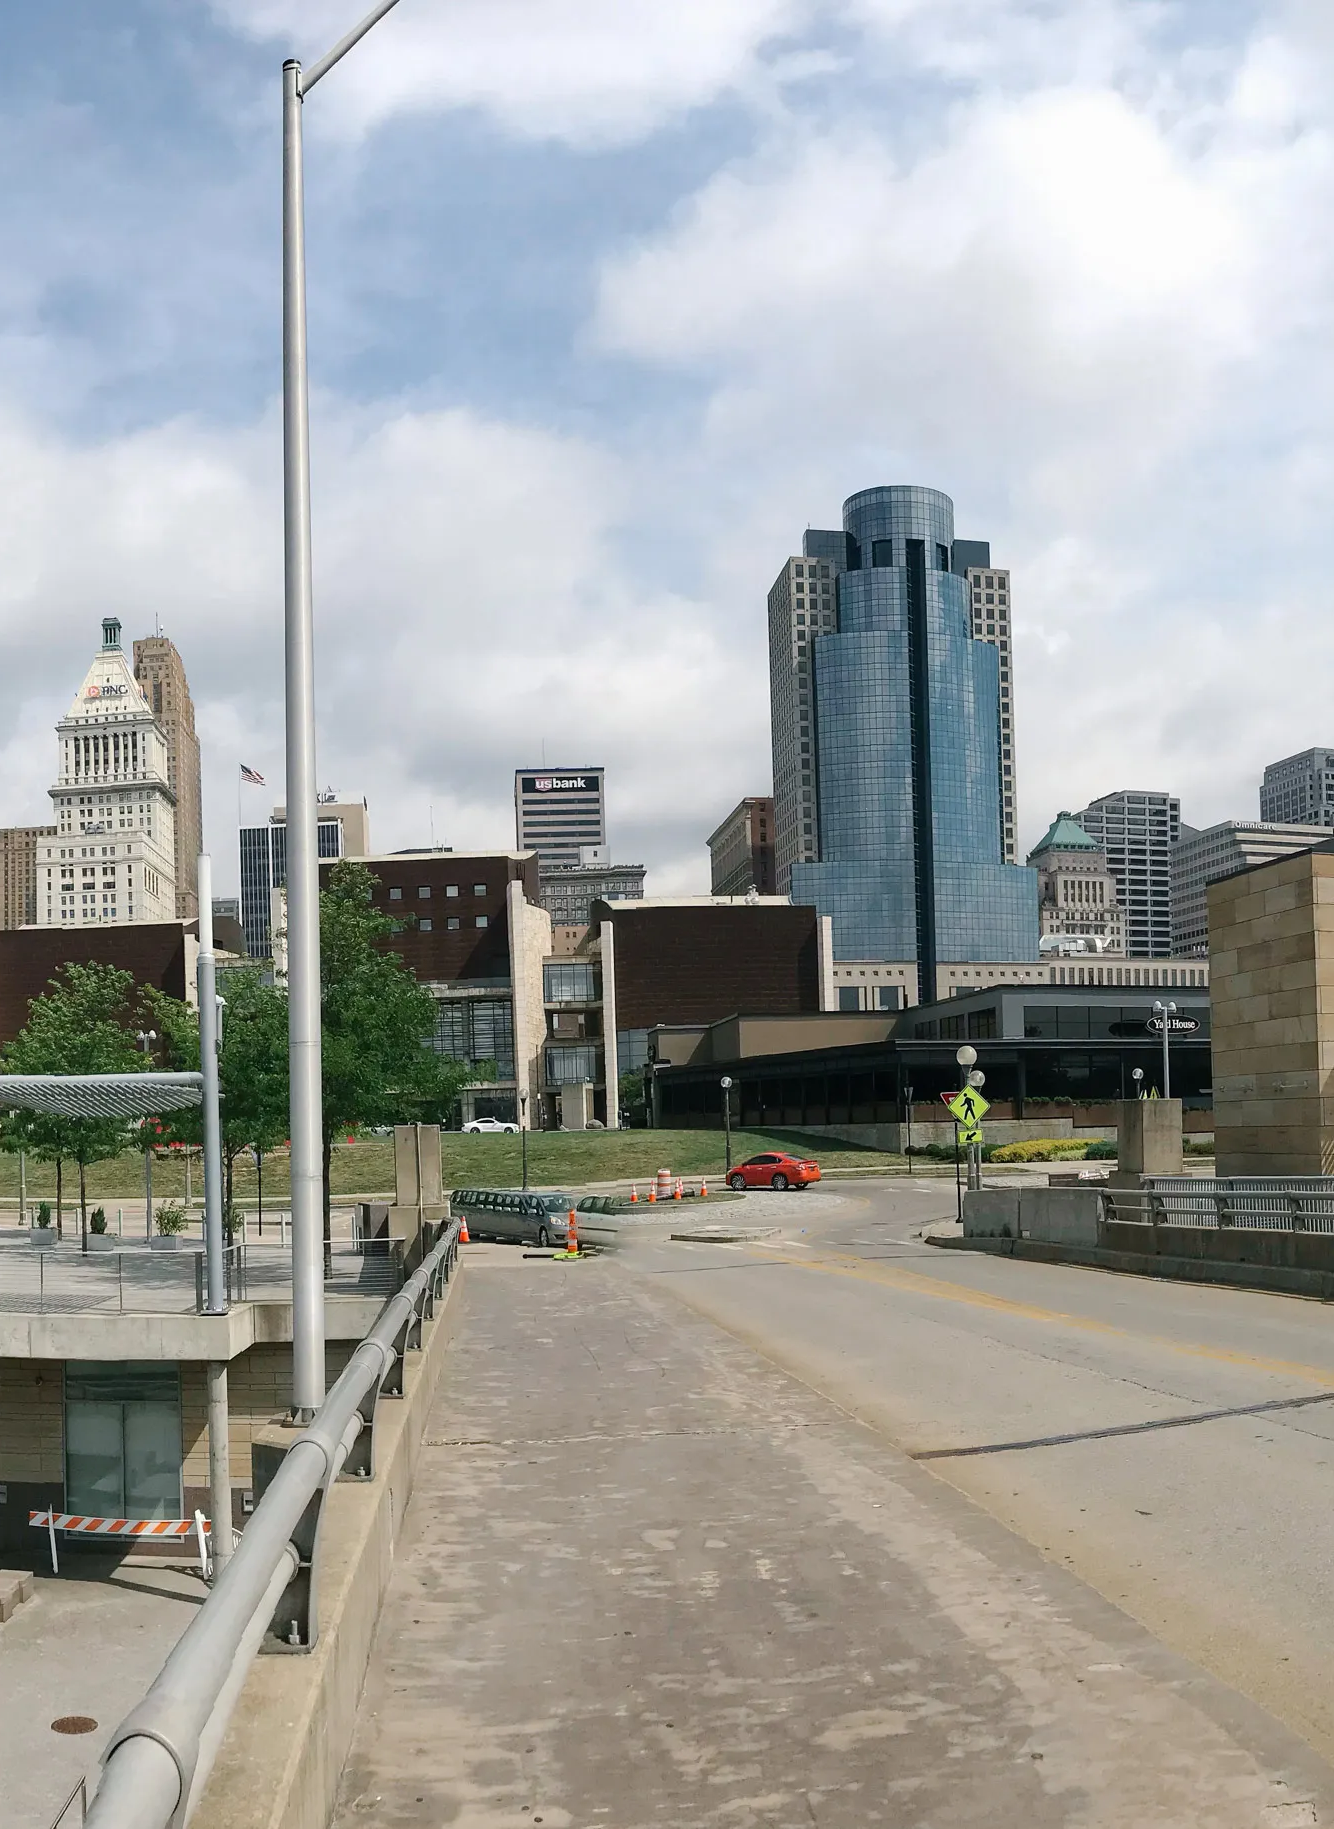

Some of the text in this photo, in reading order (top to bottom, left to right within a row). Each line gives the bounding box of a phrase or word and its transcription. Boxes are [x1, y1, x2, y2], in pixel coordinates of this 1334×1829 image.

[1235, 820, 1277, 830] Omnicare
[1154, 1019, 1196, 1029] Yad House
